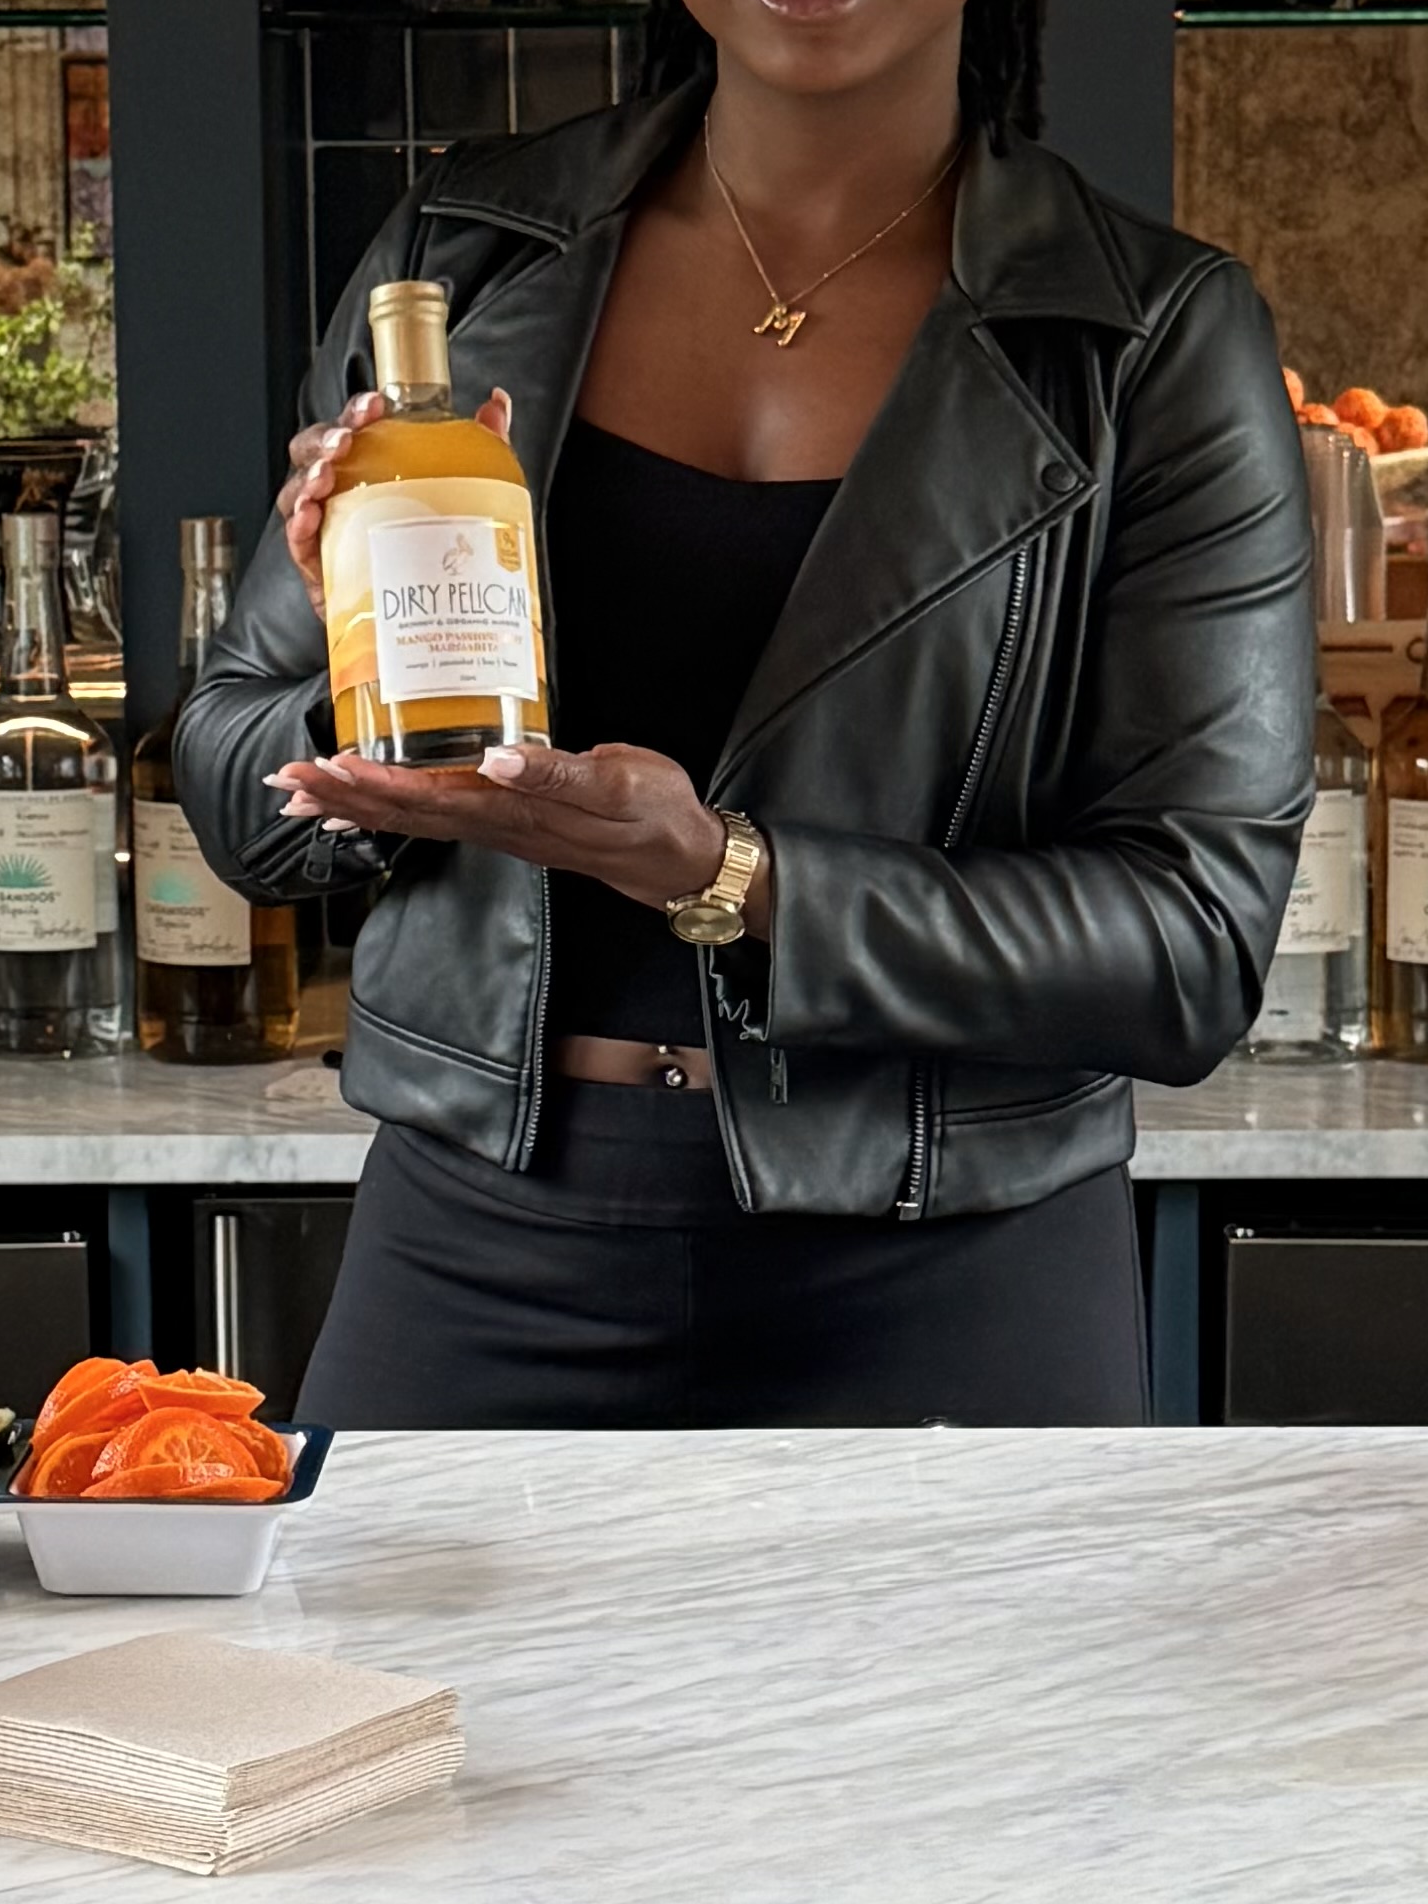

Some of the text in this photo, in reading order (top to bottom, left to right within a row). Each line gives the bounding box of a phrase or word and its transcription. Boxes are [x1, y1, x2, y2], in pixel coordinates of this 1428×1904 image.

[382, 581, 529, 621] DIRTY PELICAN
[395, 632, 443, 647] MANGO
